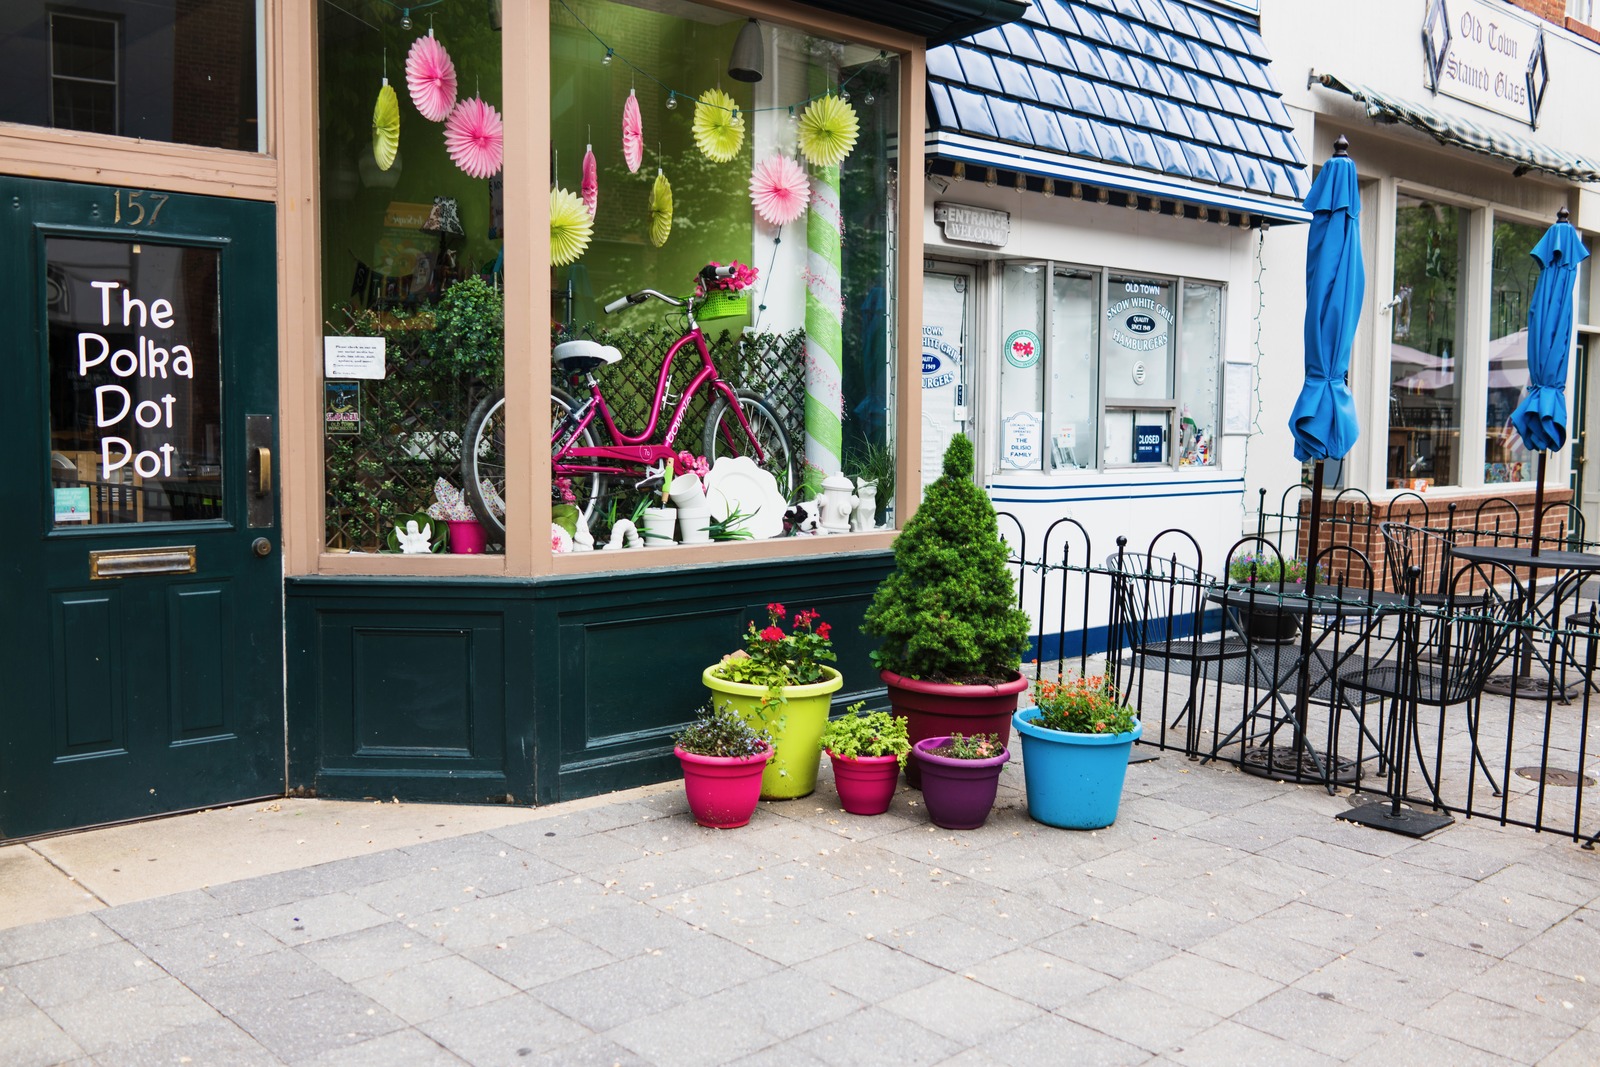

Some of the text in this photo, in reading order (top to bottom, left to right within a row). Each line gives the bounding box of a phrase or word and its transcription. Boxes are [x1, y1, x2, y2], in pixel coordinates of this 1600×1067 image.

[1461, 11, 1517, 59] Old Town
[1446, 51, 1525, 106] Stained Glass
[114, 190, 169, 226] 157
[948, 207, 1008, 230] ENTRANCE
[951, 223, 1006, 241] WELCOME
[1125, 282, 1160, 295] OLD TOWN
[91, 281, 175, 329] The
[1106, 297, 1174, 325] SNOW WHITE GRILL
[922, 326, 944, 336] TOWN
[922, 337, 939, 350] HITE
[1112, 330, 1168, 351] HAMBURGERS
[78, 332, 194, 379] Polka
[95, 385, 176, 428] Dot
[1138, 434, 1160, 445] CLOSED
[101, 436, 174, 480] Pot
